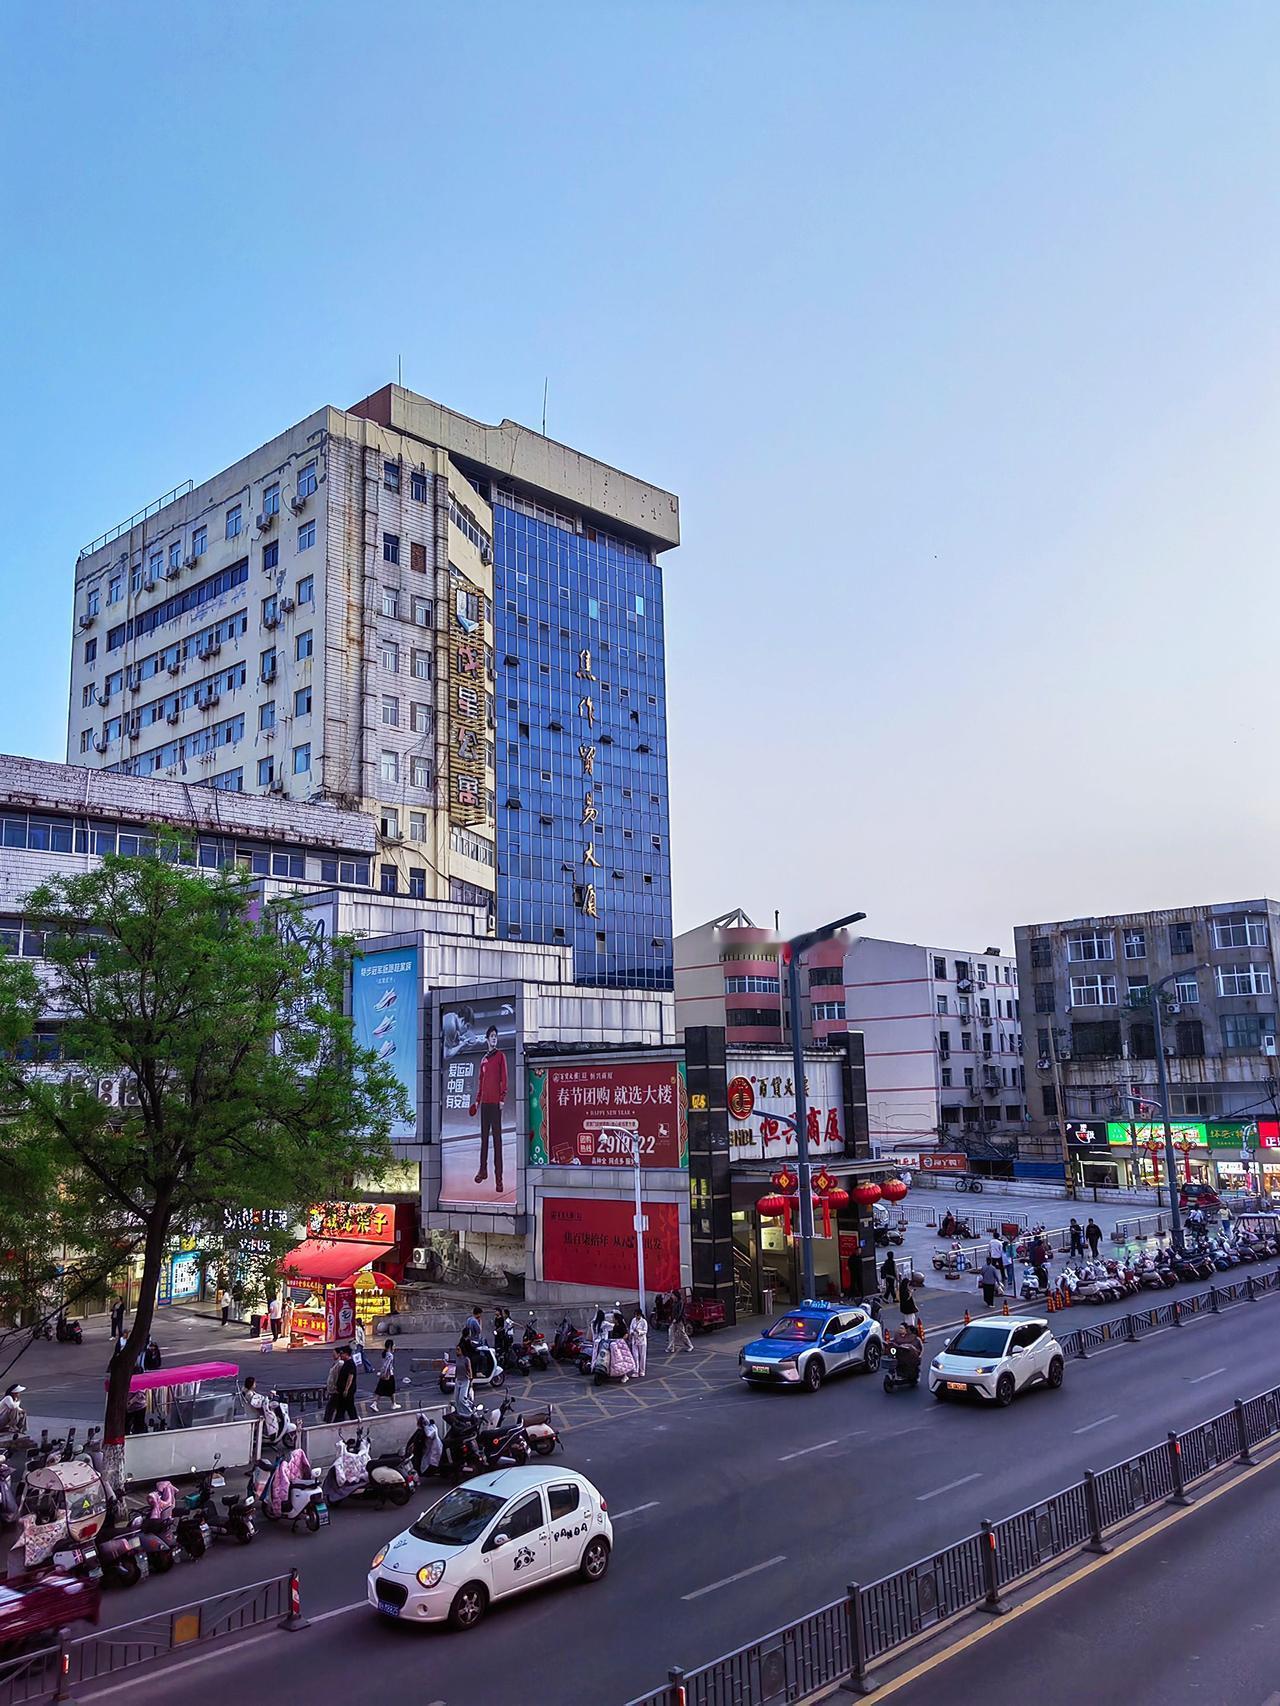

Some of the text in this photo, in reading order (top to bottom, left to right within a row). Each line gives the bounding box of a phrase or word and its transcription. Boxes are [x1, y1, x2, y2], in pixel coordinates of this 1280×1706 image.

[448, 1063, 474, 1077] 爱运动
[447, 1079, 464, 1093] 中国
[446, 1094, 471, 1109] 有安踏
[557, 1084, 673, 1106] 春节团购 就选大楼
[554, 1522, 588, 1542] PANDA
